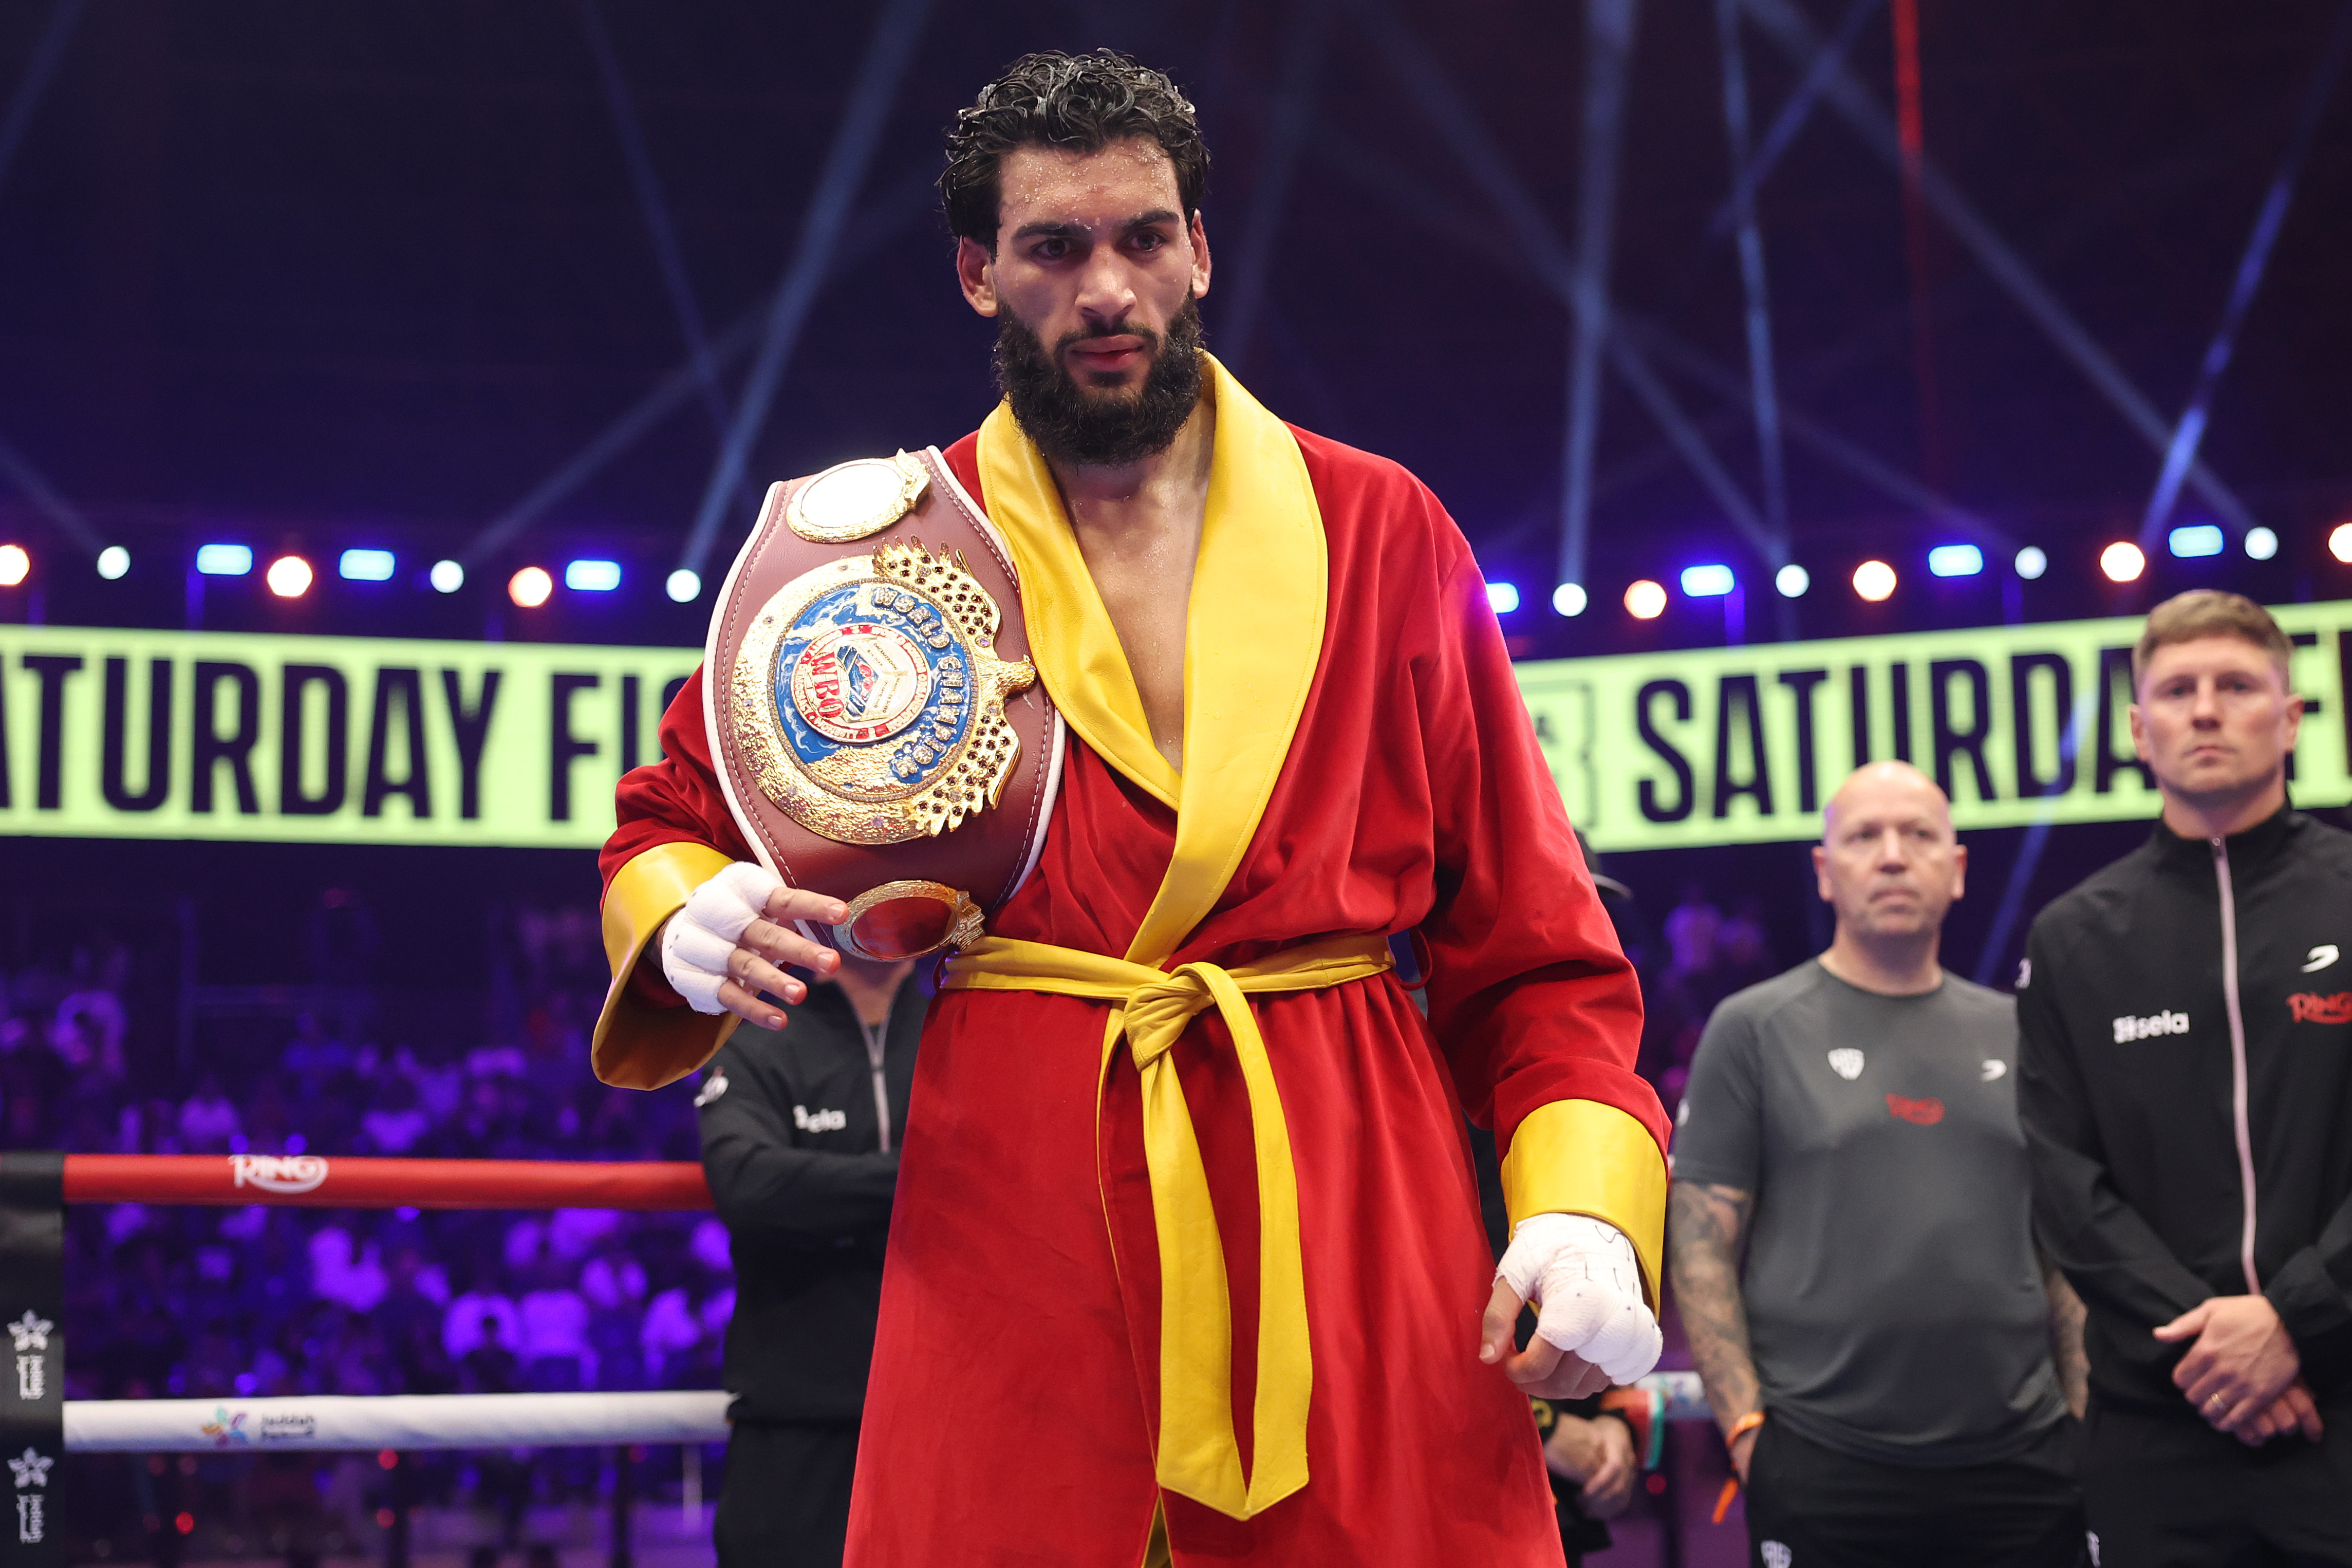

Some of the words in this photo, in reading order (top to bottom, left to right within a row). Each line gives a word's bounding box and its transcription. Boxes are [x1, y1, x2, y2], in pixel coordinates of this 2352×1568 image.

[872, 587, 950, 649] WORLD
[811, 650, 845, 718] WBO
[904, 642, 926, 674] BOXING
[886, 673, 928, 732] ORGANIZATION
[894, 656, 963, 778] CHAMPION
[1636, 646, 2157, 823] SATURDA
